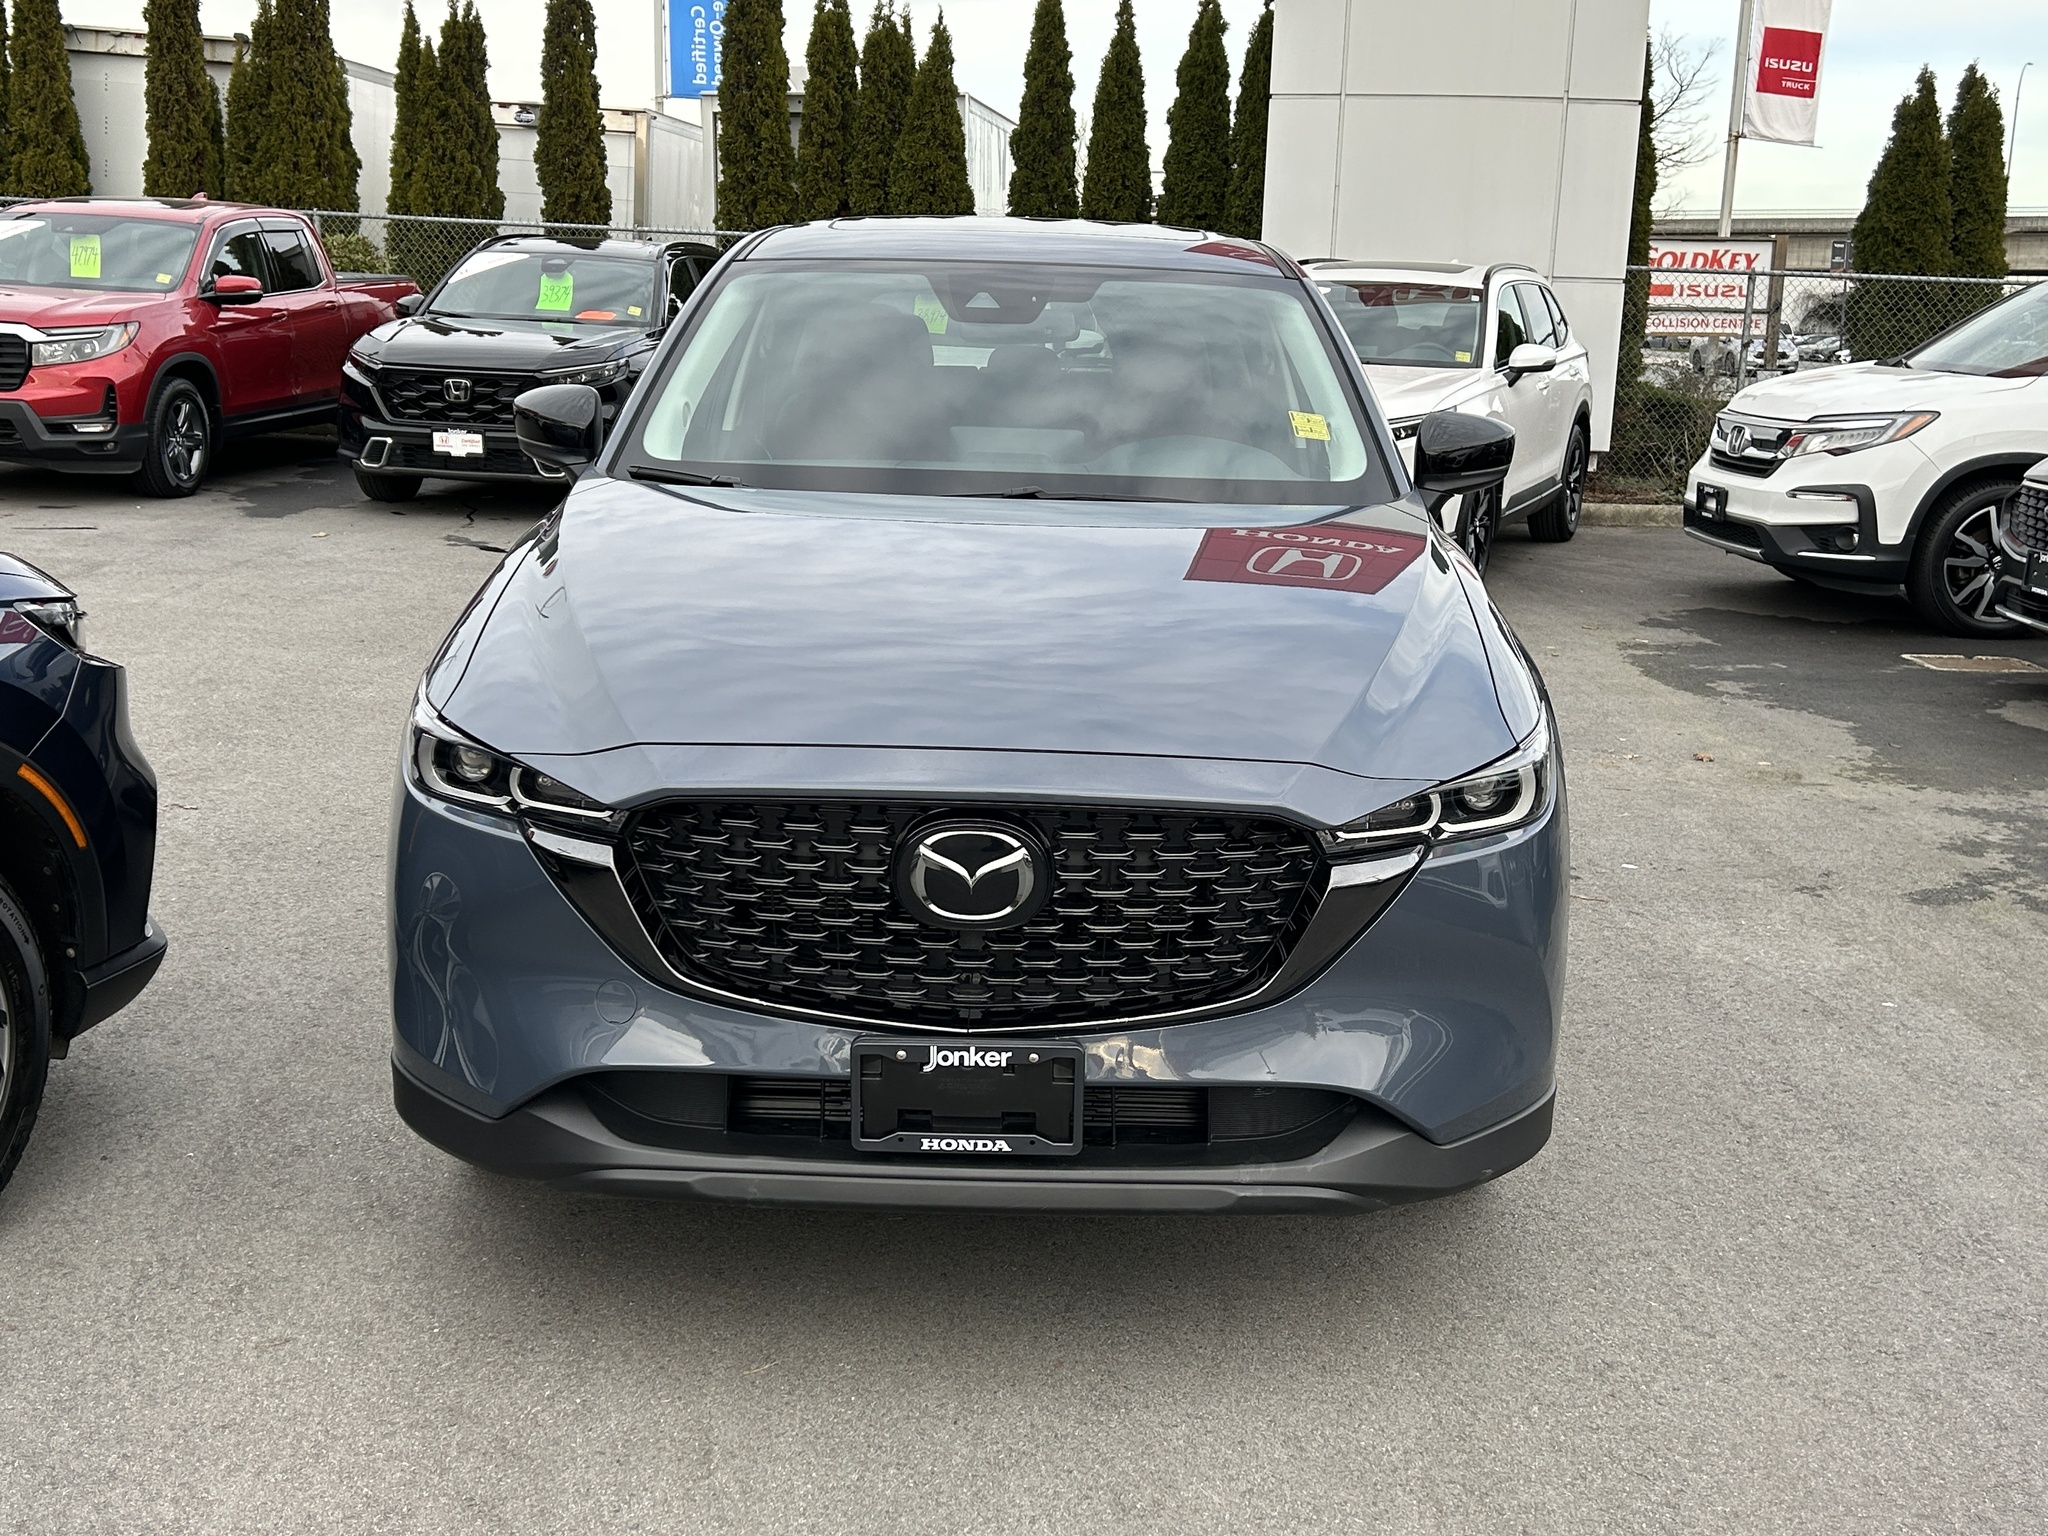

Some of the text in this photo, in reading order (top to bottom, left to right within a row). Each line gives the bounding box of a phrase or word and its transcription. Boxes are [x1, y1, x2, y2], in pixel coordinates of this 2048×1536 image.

[1764, 57, 1813, 73] ISUZU
[1781, 80, 1810, 90] TRUCK
[923, 1046, 1012, 1073] Jonker
[920, 1138, 1012, 1152] HONDA
